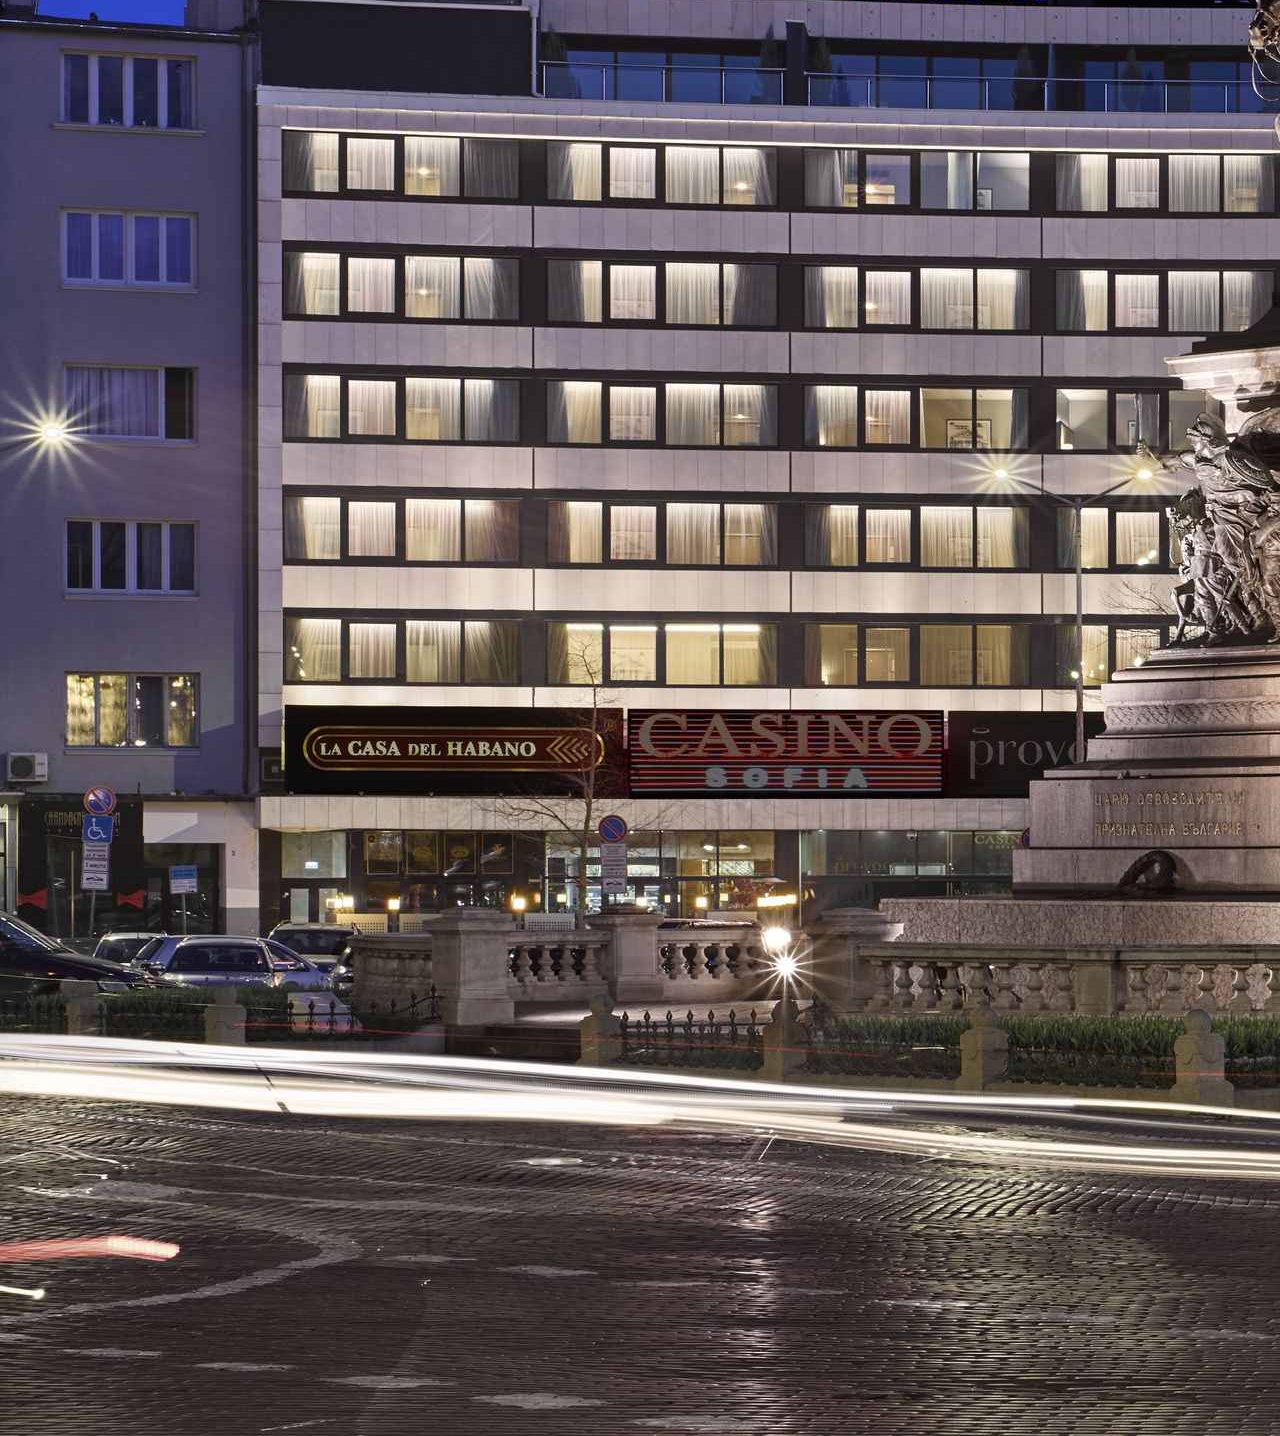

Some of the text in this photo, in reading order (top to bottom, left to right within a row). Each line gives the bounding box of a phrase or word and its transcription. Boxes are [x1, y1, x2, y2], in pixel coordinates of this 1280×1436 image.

[638, 713, 933, 758] CASINO
[319, 740, 537, 757] LA CASA DEL HABANO
[704, 767, 869, 788] SOFIA
[1094, 792, 1130, 806] ЦАРЮ
[1094, 822, 1244, 837] ПРИЗНАТЕЛНА БЪЛГАРИЯ
[974, 834, 1020, 845] CASIN
